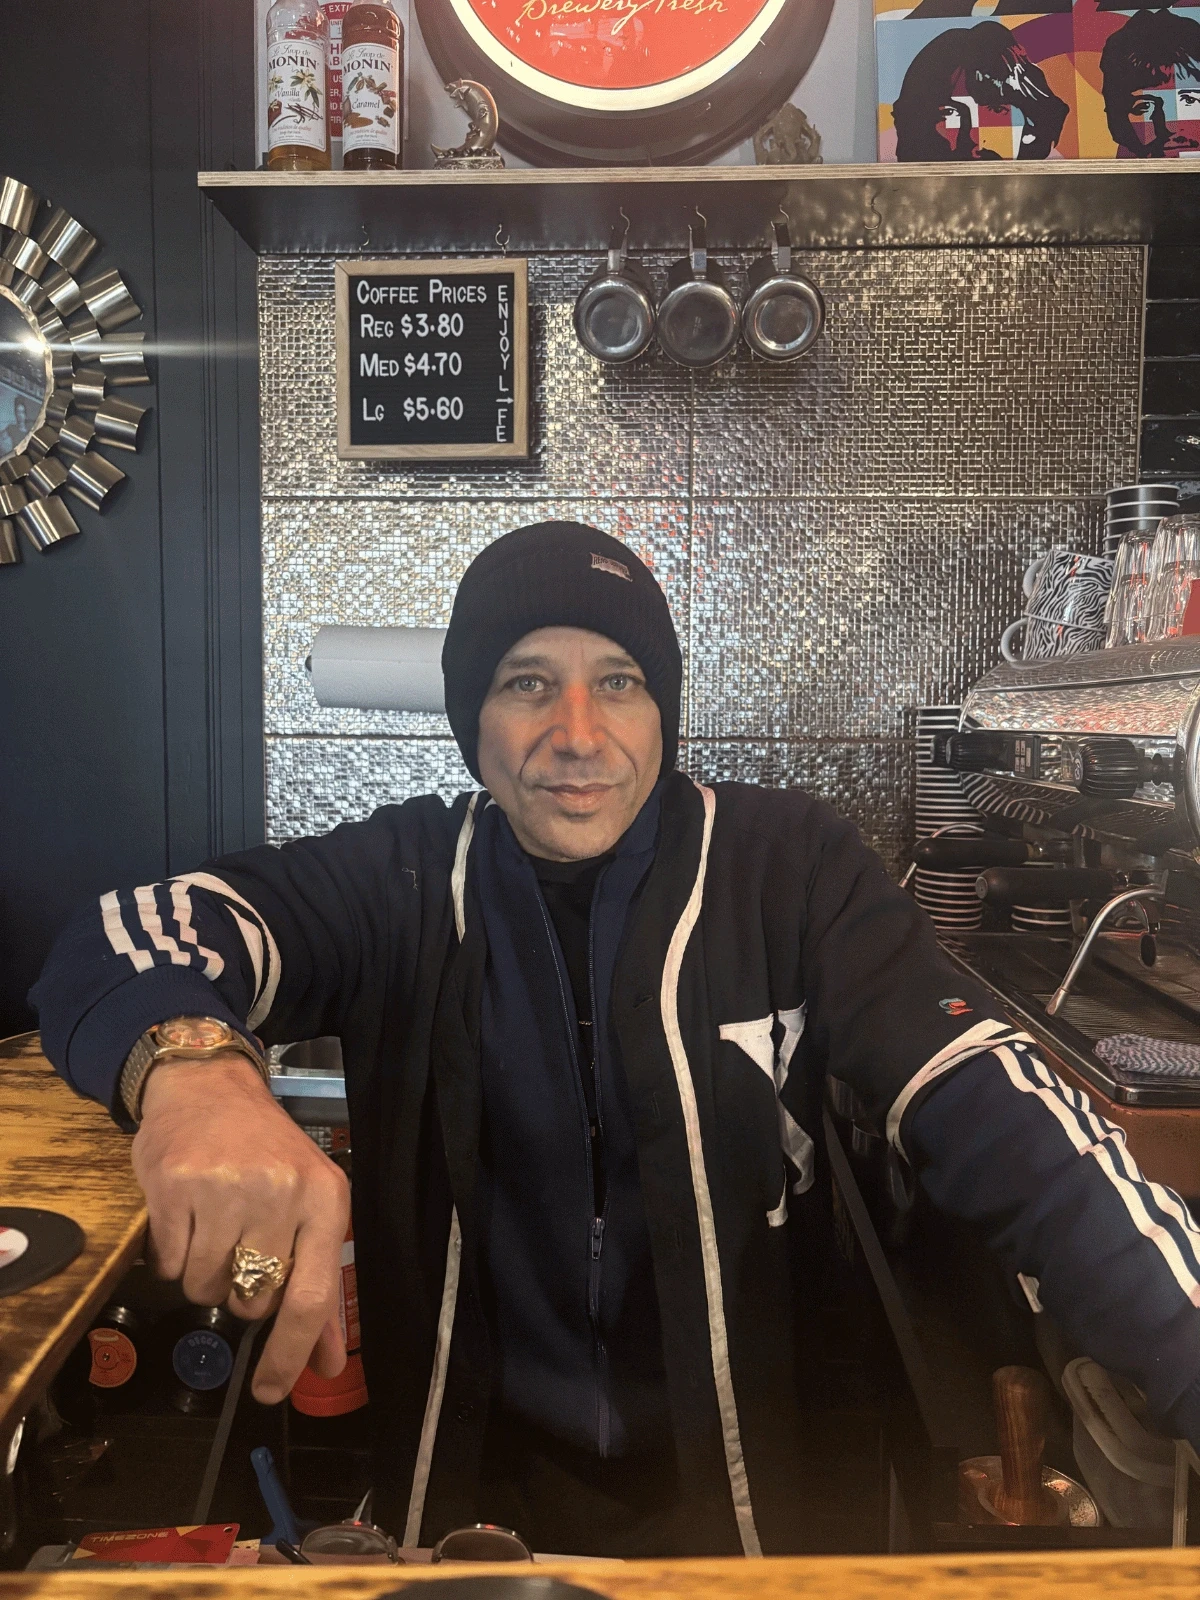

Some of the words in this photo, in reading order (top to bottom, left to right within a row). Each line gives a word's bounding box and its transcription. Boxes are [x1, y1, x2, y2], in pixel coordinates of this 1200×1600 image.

[268, 55, 317, 72] MONIN
[343, 58, 391, 76] MONIN
[275, 86, 300, 98] Vanilla
[351, 98, 381, 110] Caramel
[401, 312, 464, 339] $3.80
[404, 352, 462, 378] $4.70
[403, 396, 464, 422] $5.60
[90, 1531, 169, 1544] TIMEZONE
